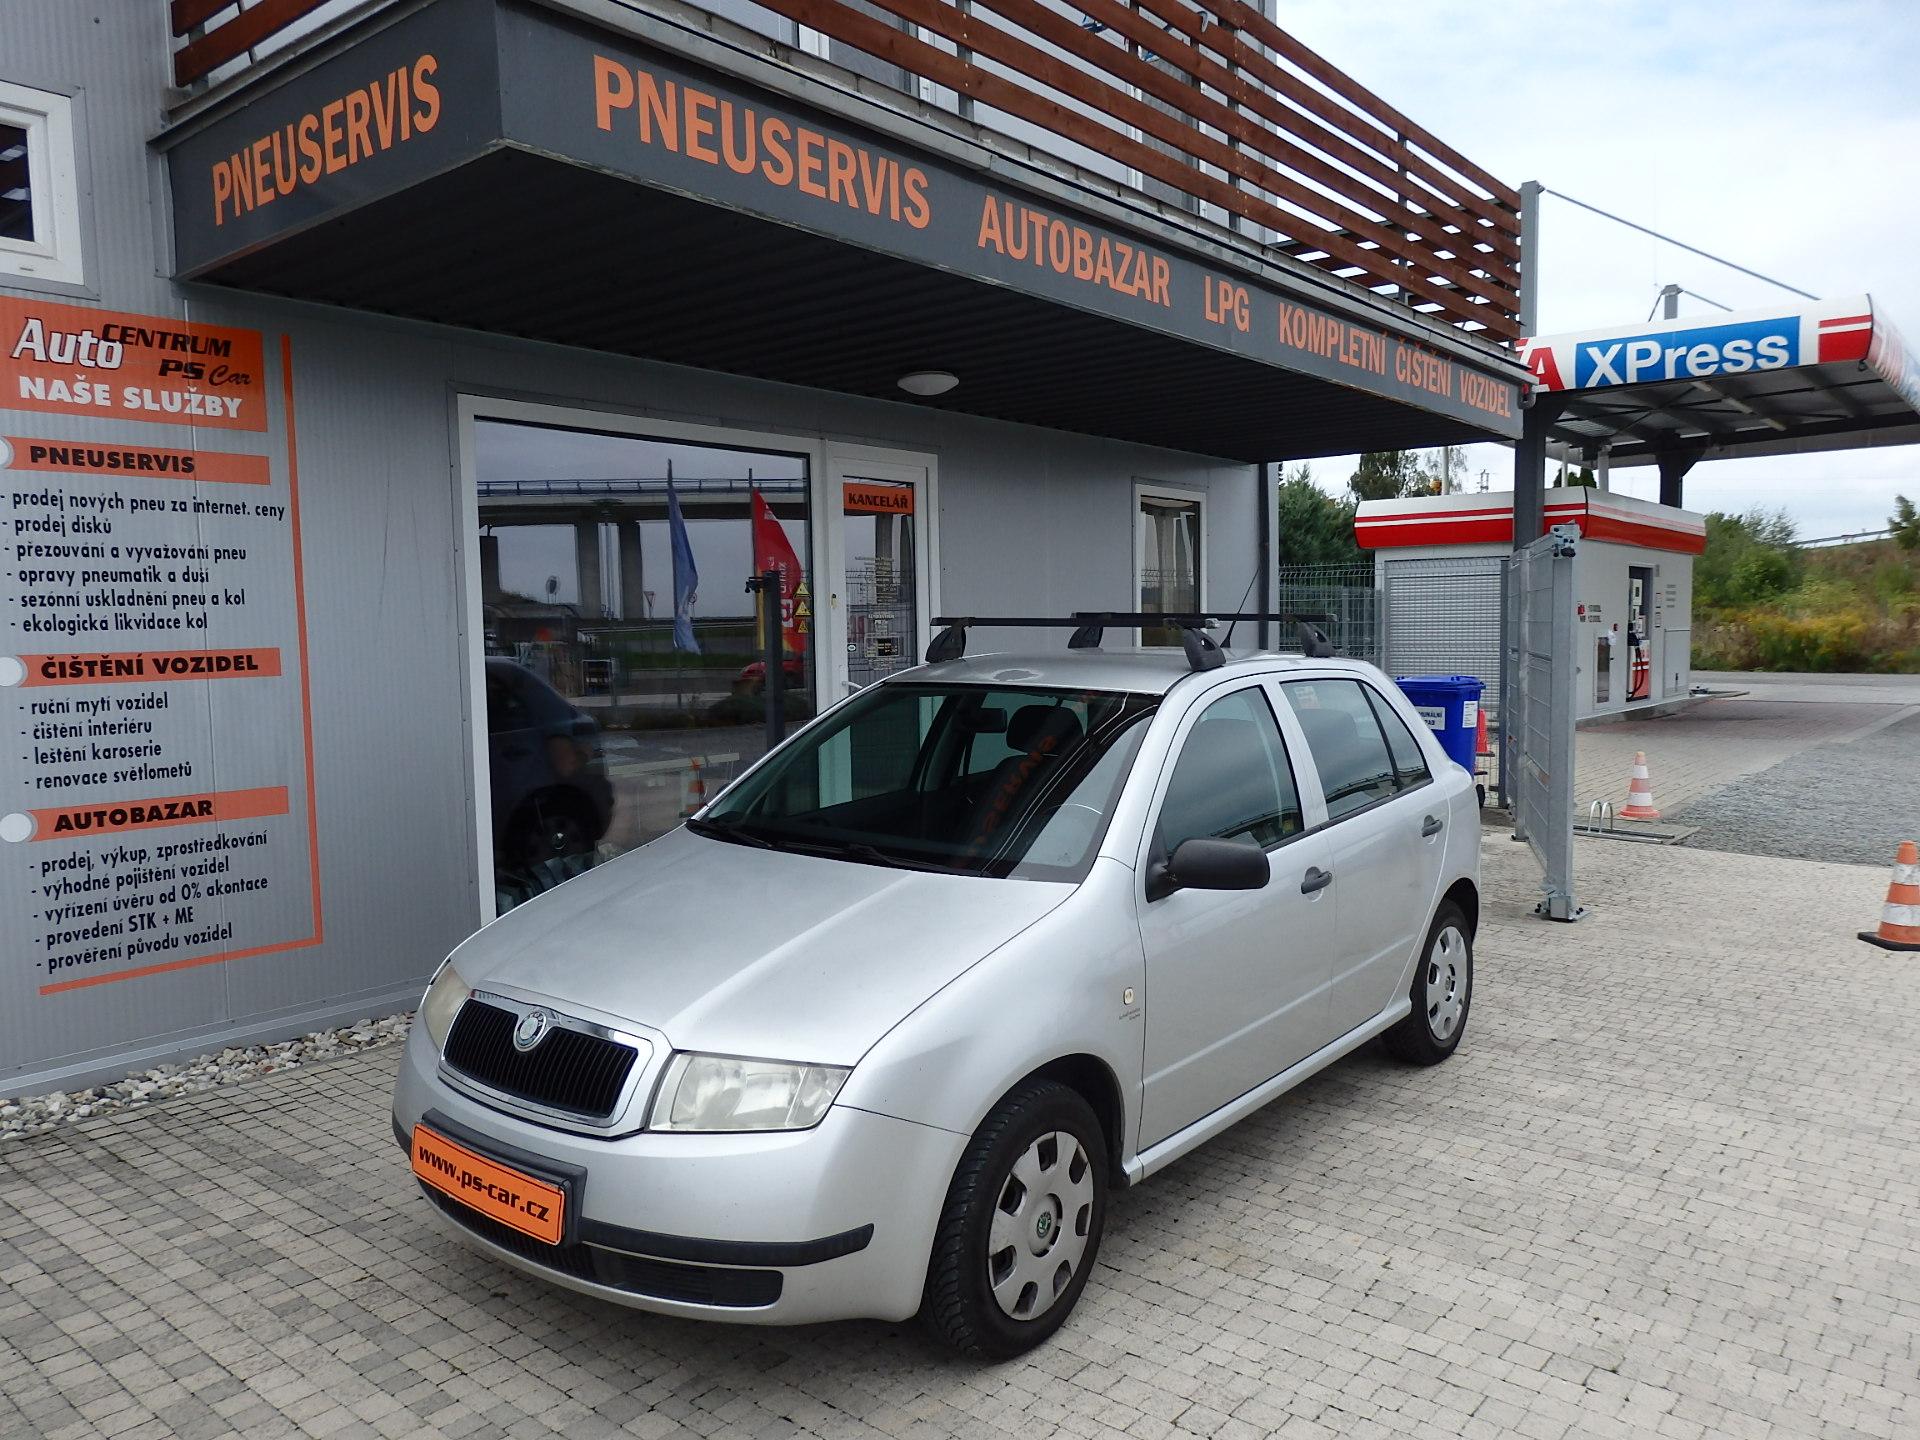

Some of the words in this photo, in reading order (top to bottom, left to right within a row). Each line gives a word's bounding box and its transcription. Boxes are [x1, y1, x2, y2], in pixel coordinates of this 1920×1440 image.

[212, 54, 440, 226] PNEUSERVIS
[592, 54, 930, 229] PNEUSERVIS
[977, 195, 1171, 307] AUTOBAZAR
[1205, 276, 1250, 332] LPG
[1278, 302, 1387, 375] KOMPLETNÍ
[1395, 336, 1452, 397] ČIŠTĚNÍ
[1460, 369, 1511, 418] VOZIDEL
[10, 317, 124, 370] Auto
[101, 324, 232, 358] CENTRUM
[158, 359, 206, 380] PS
[208, 365, 252, 386] Car
[1584, 335, 1789, 389] XPress
[19, 374, 112, 407] NAŠE
[124, 386, 243, 419] SLUŽBY
[30, 446, 195, 474] PNEUSERVIS
[13, 488, 64, 511] prodej
[70, 492, 124, 513] nových
[131, 498, 165, 514] pneu
[171, 501, 187, 512] za
[193, 497, 251, 516] internet.
[255, 505, 285, 521] ceny
[848, 492, 908, 510] KANCELÁŘ
[15, 514, 66, 537] prodej
[72, 515, 111, 533] disků
[17, 541, 104, 561] přezouvání
[111, 546, 119, 557] a
[126, 543, 209, 562] vyvažování
[214, 547, 246, 563] pneu
[19, 570, 75, 586] opravy
[82, 565, 164, 586] pneumatik
[168, 571, 176, 583] a
[182, 565, 209, 583] duší
[21, 591, 80, 607] sezónní
[86, 589, 167, 607] uskladnění
[173, 592, 207, 609] pneu
[211, 594, 219, 605] a
[224, 589, 246, 605] kol
[23, 613, 109, 636] ekologická
[115, 611, 181, 631] likvidace
[186, 612, 208, 629] kol
[41, 654, 144, 679] ČIŠTĚNÍ
[152, 655, 258, 675] VOZIDEL
[31, 699, 70, 715] ruční
[76, 695, 111, 717] mytí
[117, 692, 168, 711] vozidel
[33, 722, 83, 740] čištění
[88, 719, 152, 737] interiéru
[35, 745, 86, 764] leštění
[92, 740, 162, 760] karoserie
[36, 772, 107, 789] renovace
[113, 761, 192, 784] světlometů
[54, 800, 214, 832] AUTOBAZAR
[42, 850, 95, 877] prodej,
[101, 847, 151, 868] výkup,
[156, 830, 267, 858] zprostředkování
[43, 875, 110, 901] výhodné
[116, 868, 175, 891] pojištění
[181, 857, 229, 878] vozidel
[45, 900, 108, 925] vyřízení
[113, 891, 153, 912] úvěru
[159, 886, 176, 904] od
[181, 883, 201, 903] 0%
[206, 876, 268, 897] akontace
[47, 922, 123, 949] provedení
[128, 913, 157, 934] STK
[162, 914, 169, 926] +
[175, 907, 194, 924] ME
[48, 946, 122, 974] prověření
[127, 935, 179, 961] původu
[184, 922, 232, 946] vozidel
[418, 1146, 550, 1223] www.ps-car.cz
